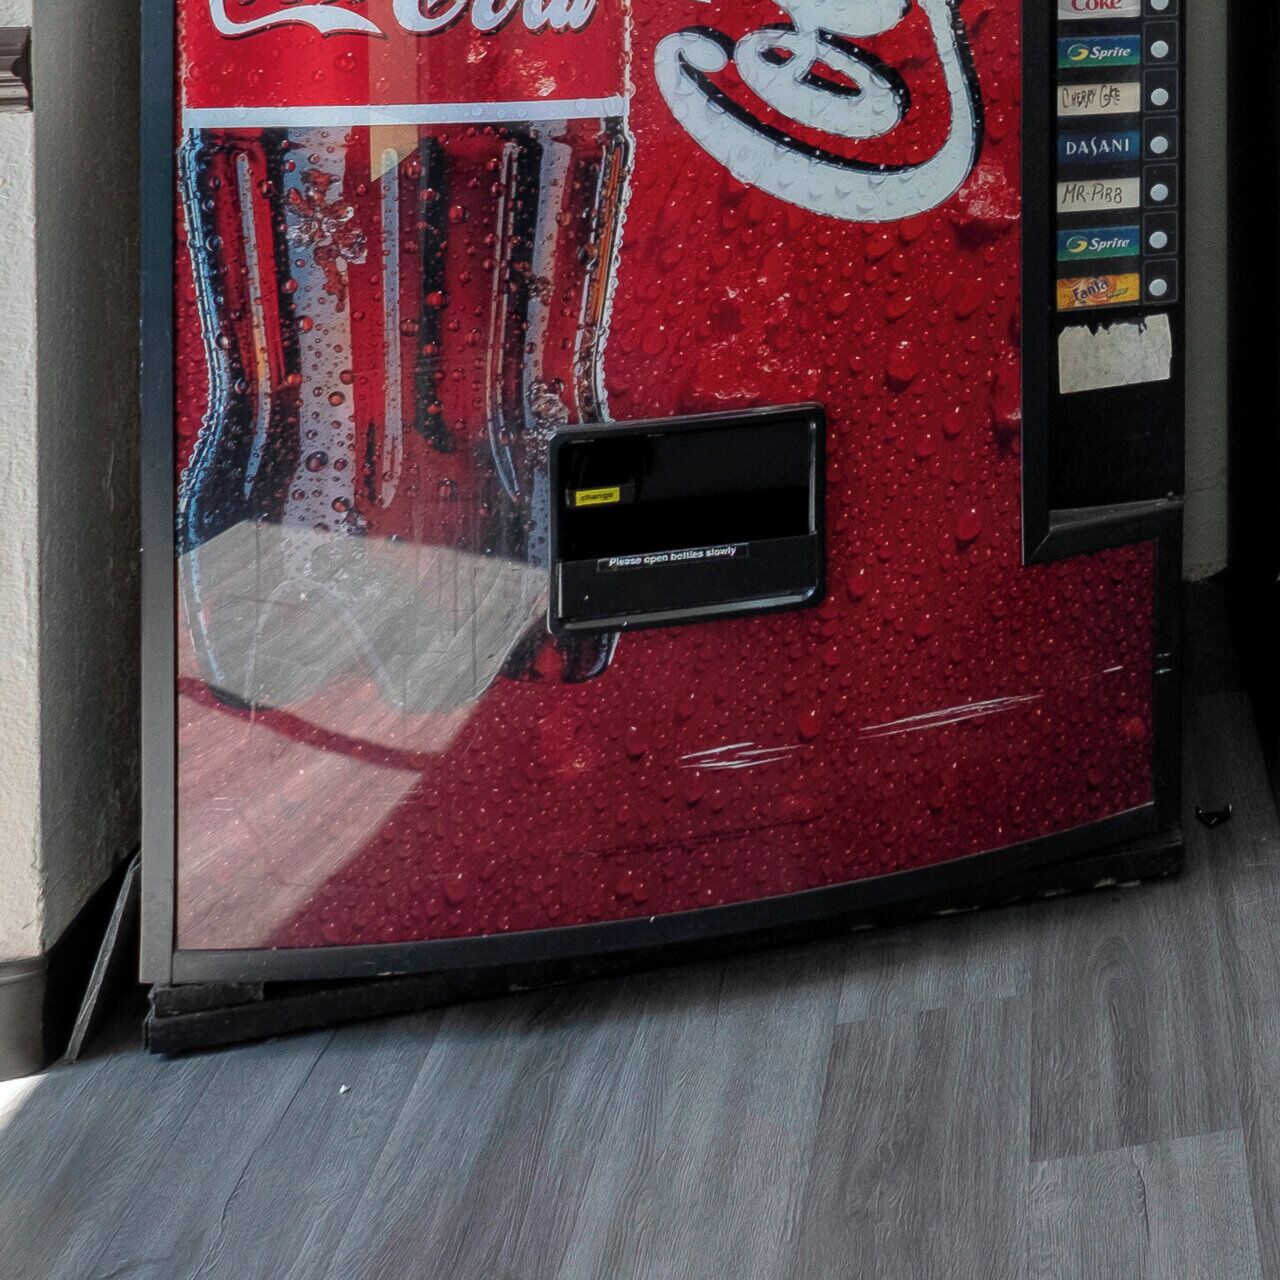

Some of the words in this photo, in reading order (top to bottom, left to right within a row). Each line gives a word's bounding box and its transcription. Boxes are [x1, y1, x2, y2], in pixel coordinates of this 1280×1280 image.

[1089, 46, 1132, 60] Sprite
[1066, 136, 1130, 157] DASANI
[1088, 237, 1130, 252] Sprite
[1072, 278, 1110, 304] Fanta
[580, 491, 614, 502] change
[608, 556, 642, 567] Please
[643, 553, 669, 564] open
[670, 550, 704, 561] bottles
[706, 546, 738, 558] slowly
